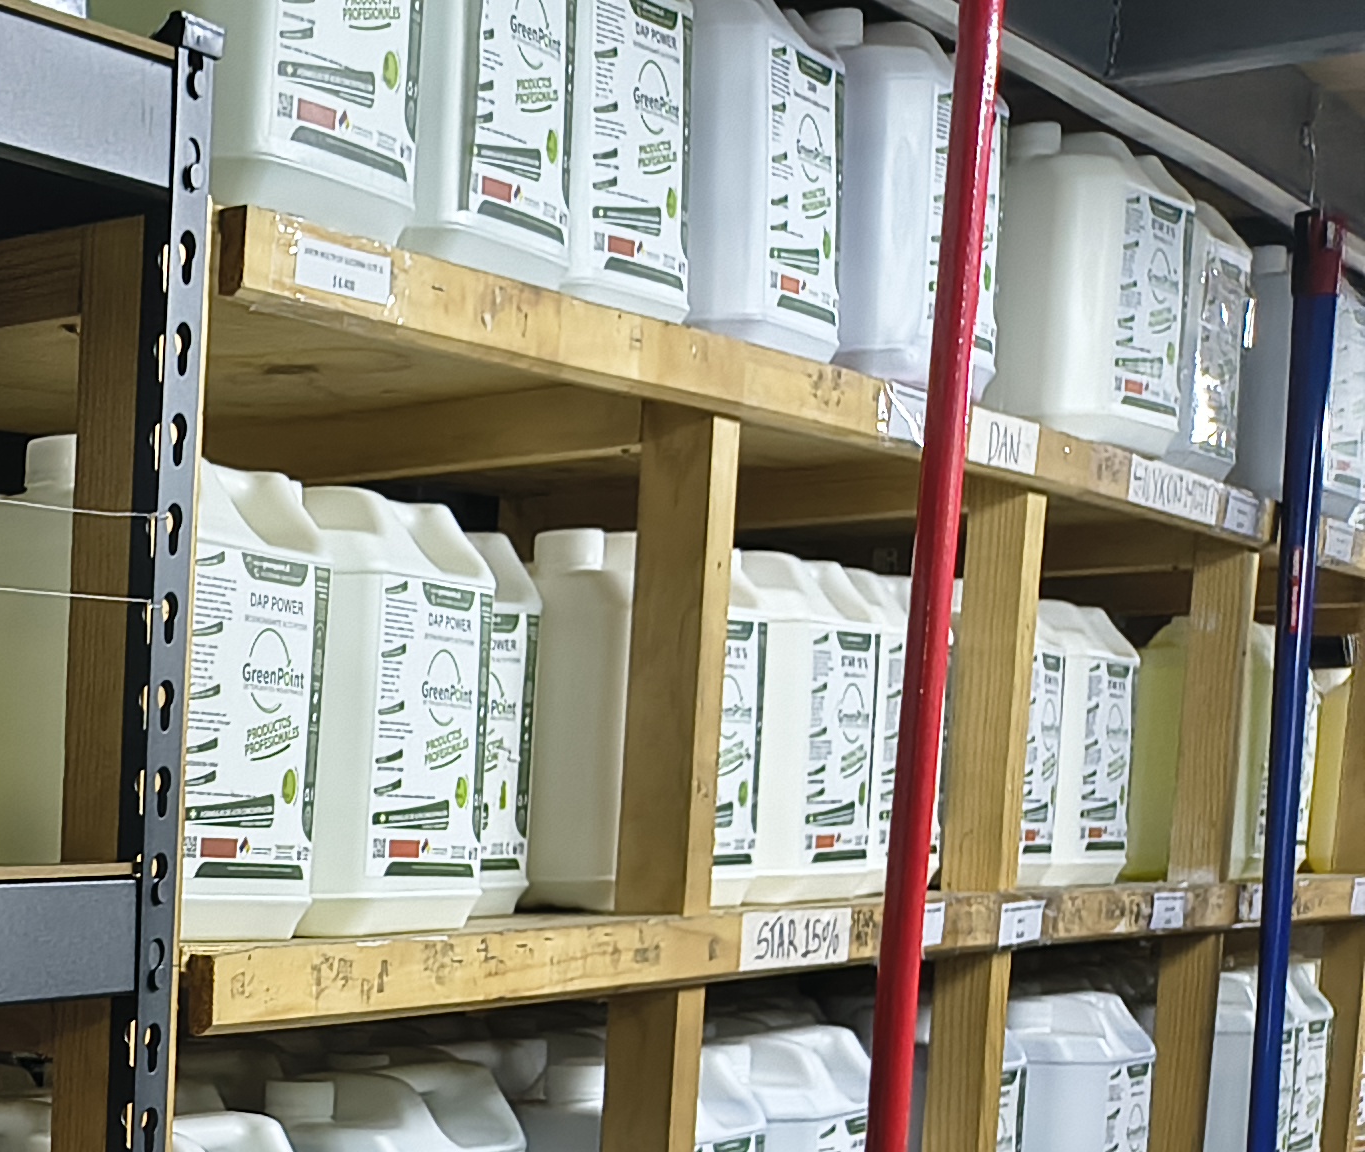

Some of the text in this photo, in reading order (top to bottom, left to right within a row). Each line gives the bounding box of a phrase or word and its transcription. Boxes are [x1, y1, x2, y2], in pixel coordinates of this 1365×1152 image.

[988, 420, 1021, 465] DAN
[250, 592, 303, 616] DAP POWER
[242, 662, 304, 690] GreenPoint
[421, 680, 473, 704] GreenPoint
[755, 915, 798, 960] STAR
